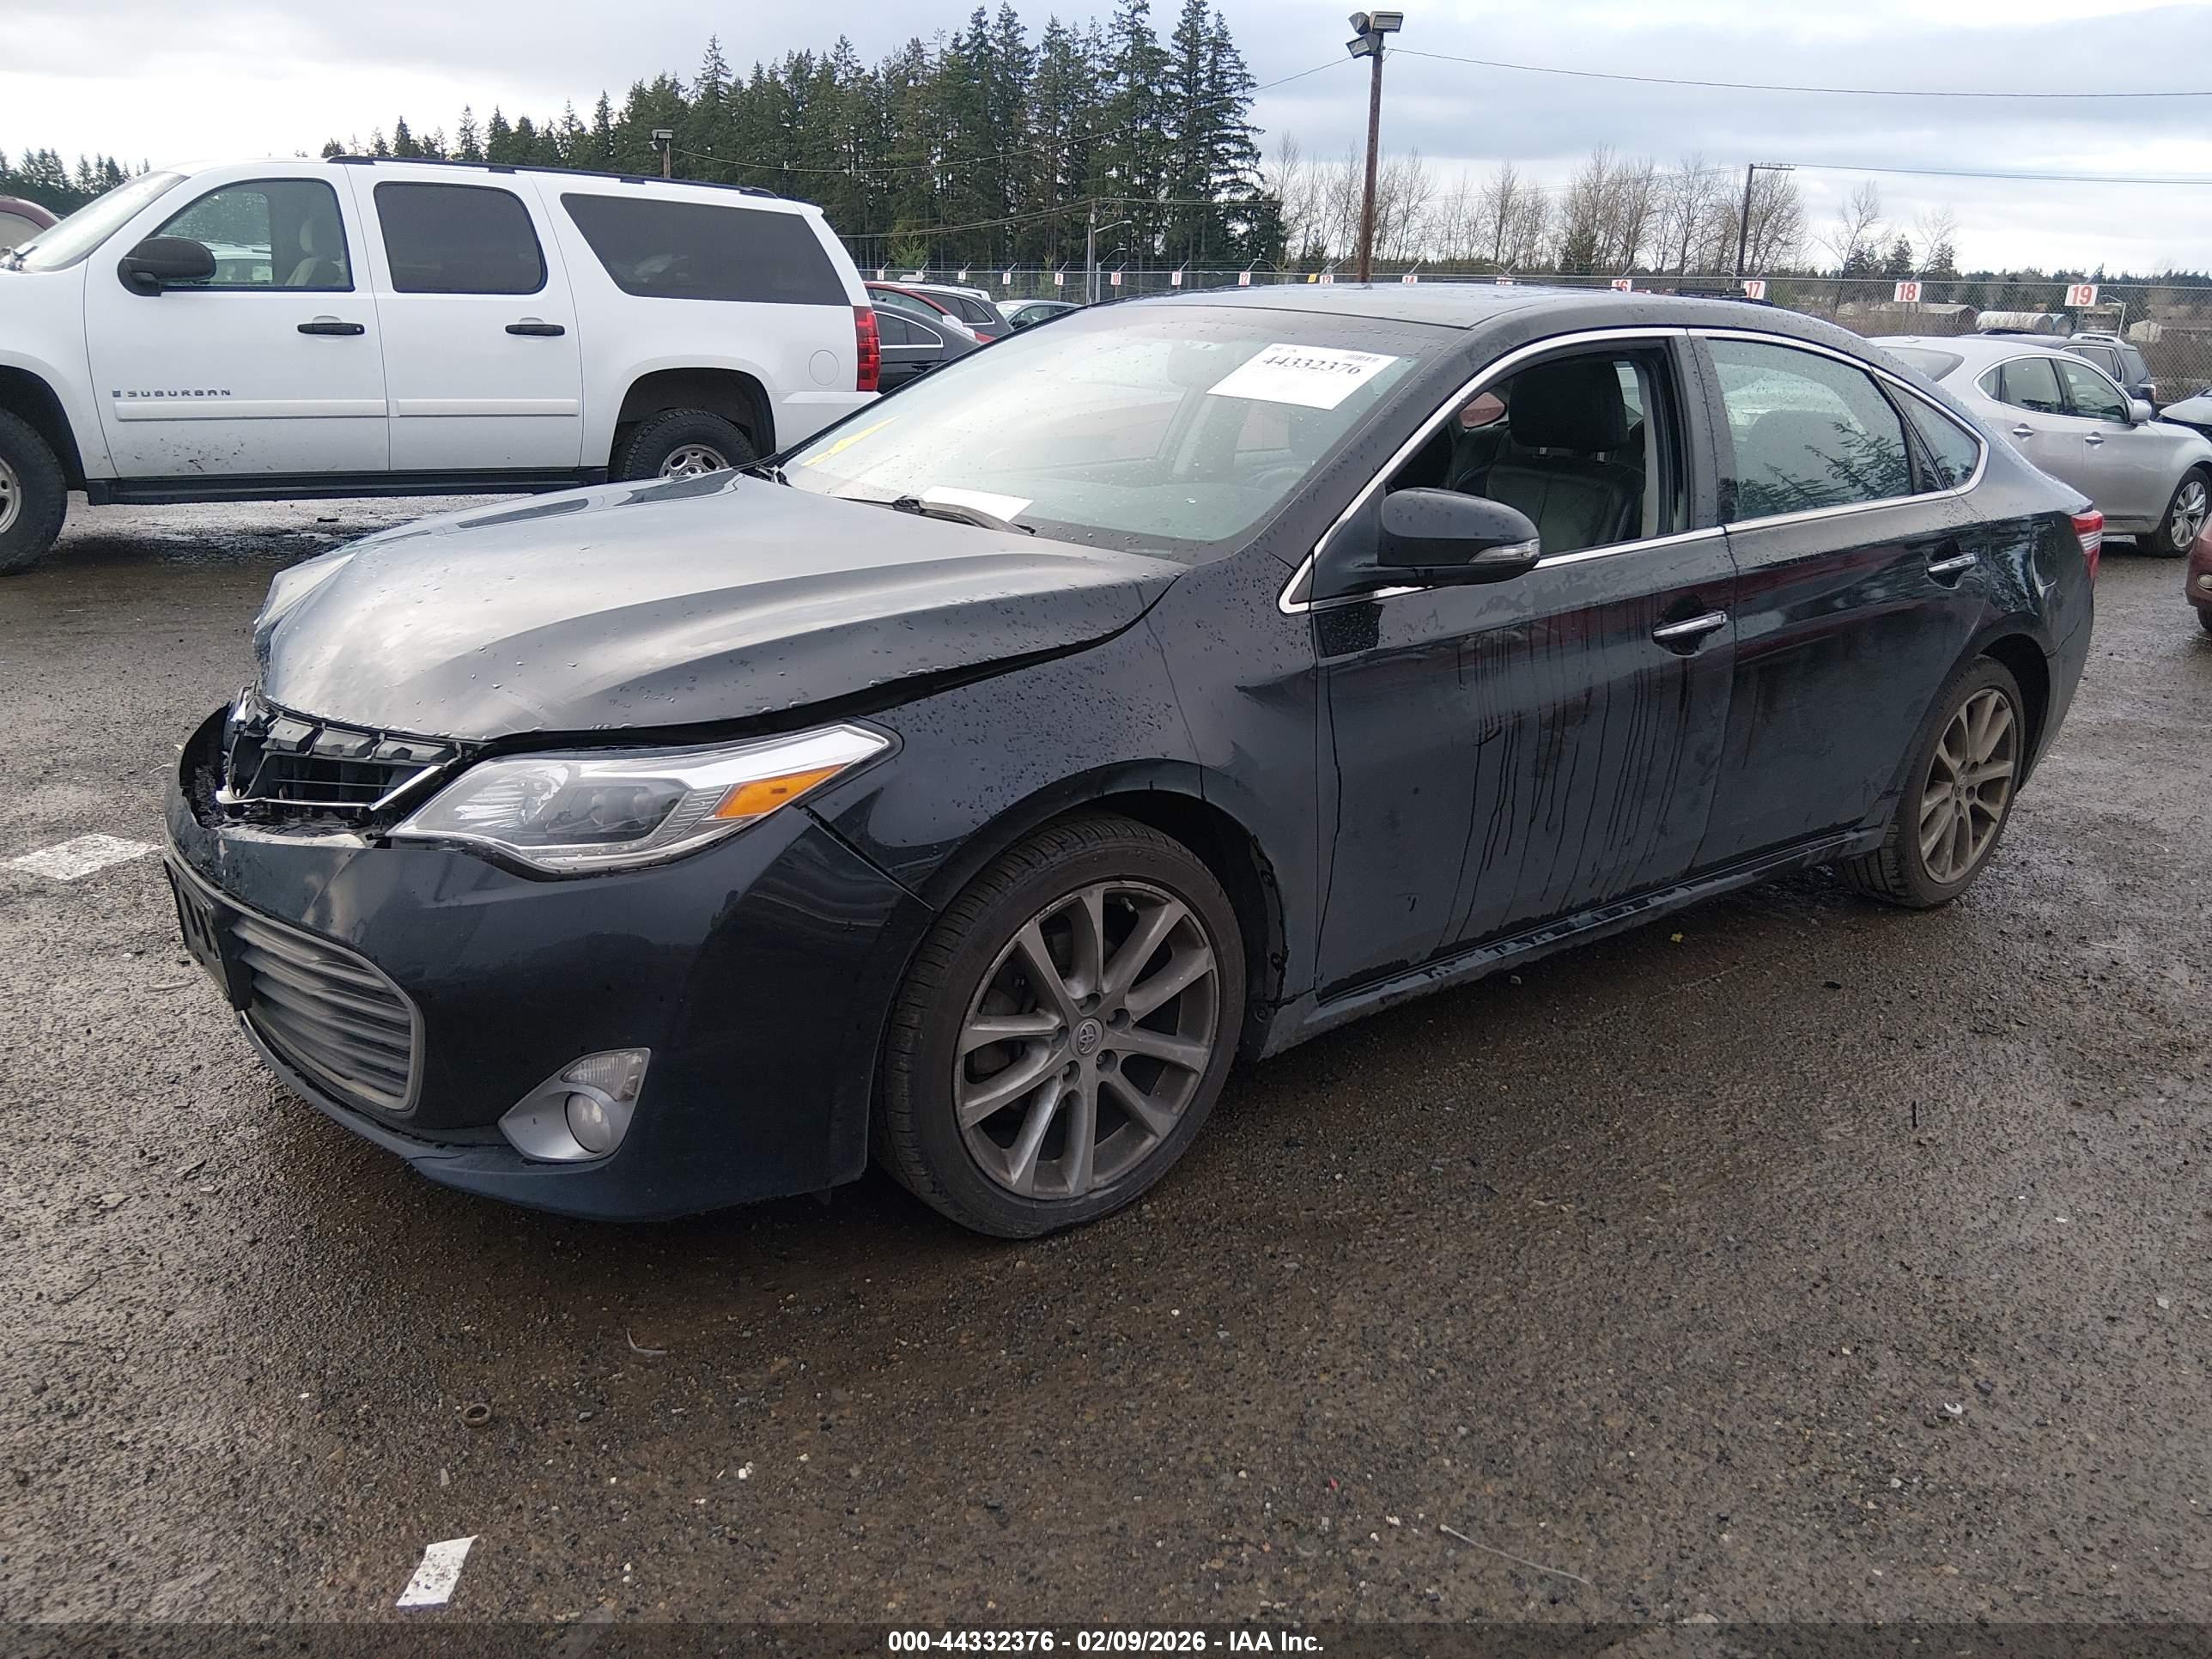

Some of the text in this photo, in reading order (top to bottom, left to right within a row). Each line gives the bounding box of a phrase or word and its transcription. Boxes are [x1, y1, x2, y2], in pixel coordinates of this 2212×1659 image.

[1112, 274, 1120, 284] 10
[1242, 273, 1249, 285] 12
[1747, 282, 1760, 298] 17
[1899, 283, 1917, 301] 18
[2071, 285, 2093, 305] 19
[1262, 355, 1366, 375] 44332376
[127, 389, 231, 398] SUBURBAN
